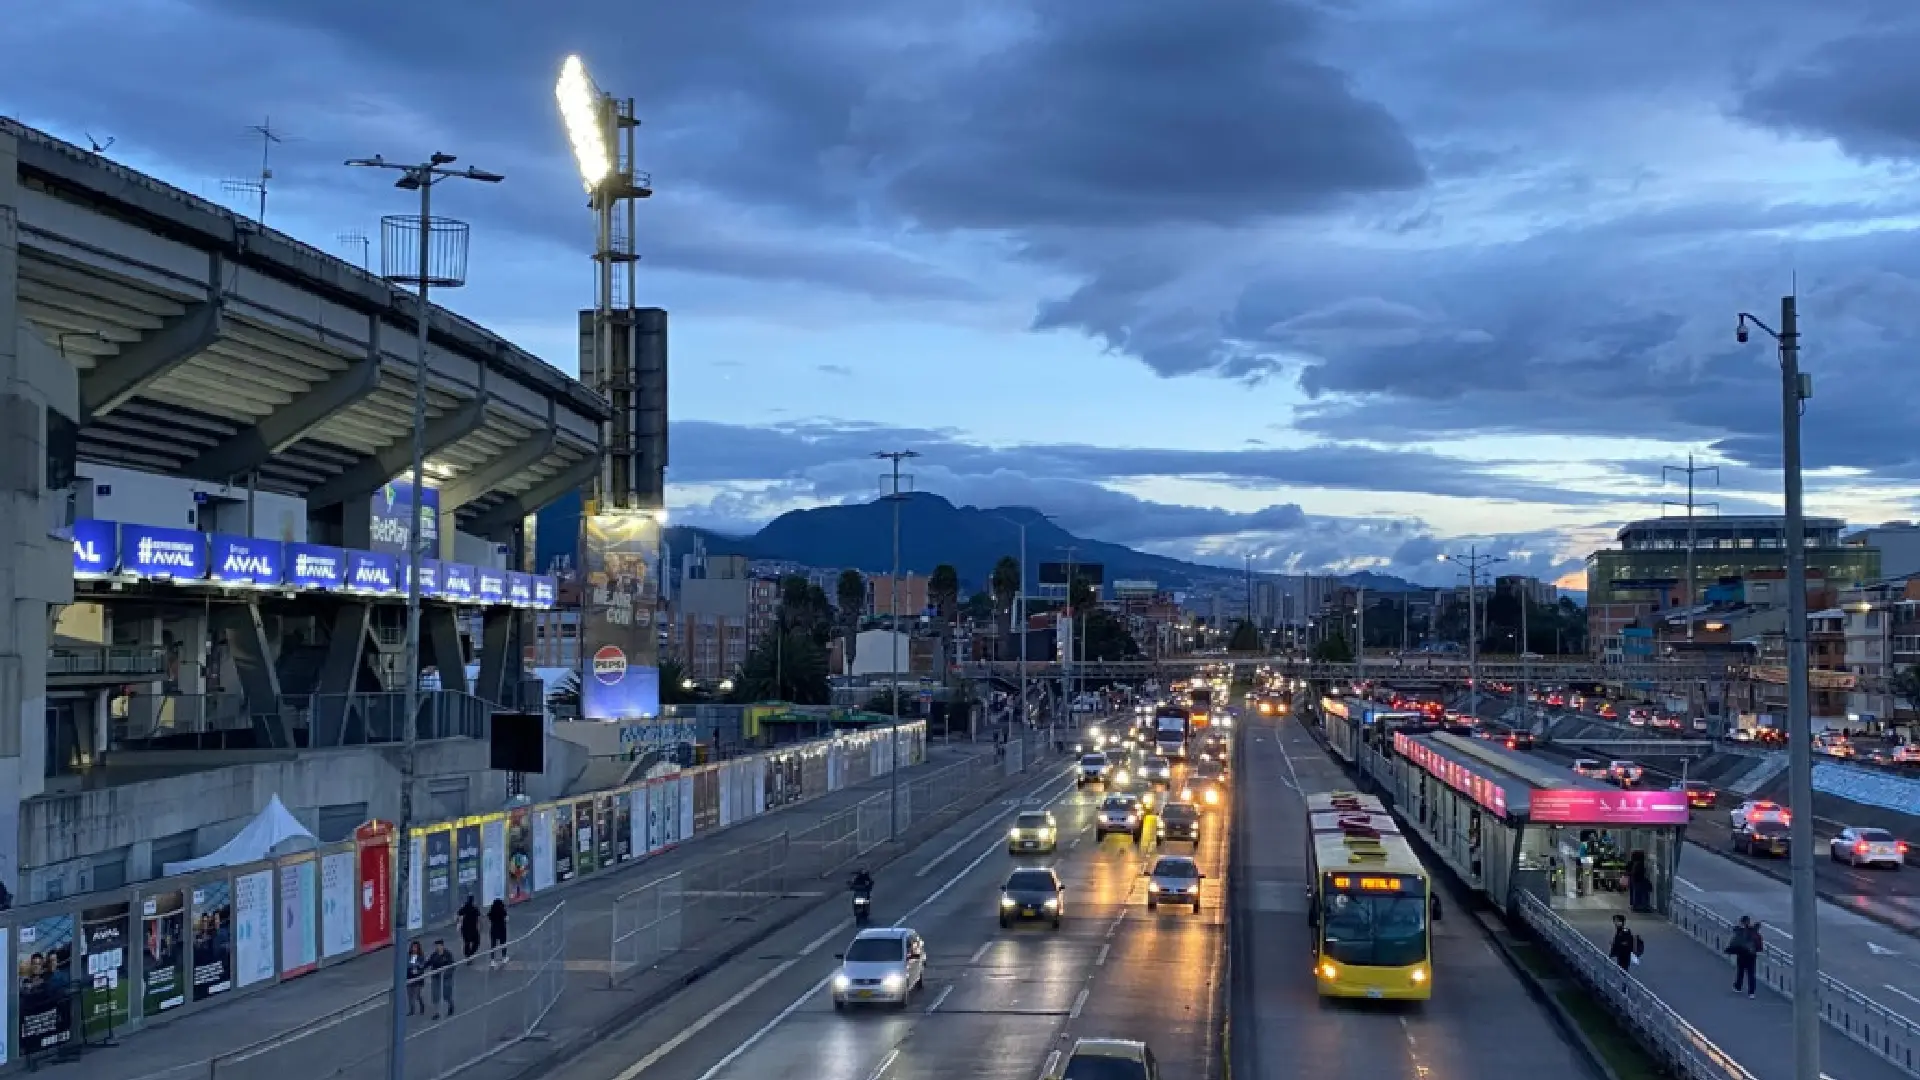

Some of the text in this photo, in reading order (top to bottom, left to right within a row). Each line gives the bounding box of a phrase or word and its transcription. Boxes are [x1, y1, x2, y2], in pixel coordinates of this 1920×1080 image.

[224, 554, 273, 576] AVAL
[356, 567, 391, 584] AVAL
[595, 660, 626, 669] PEPSI
